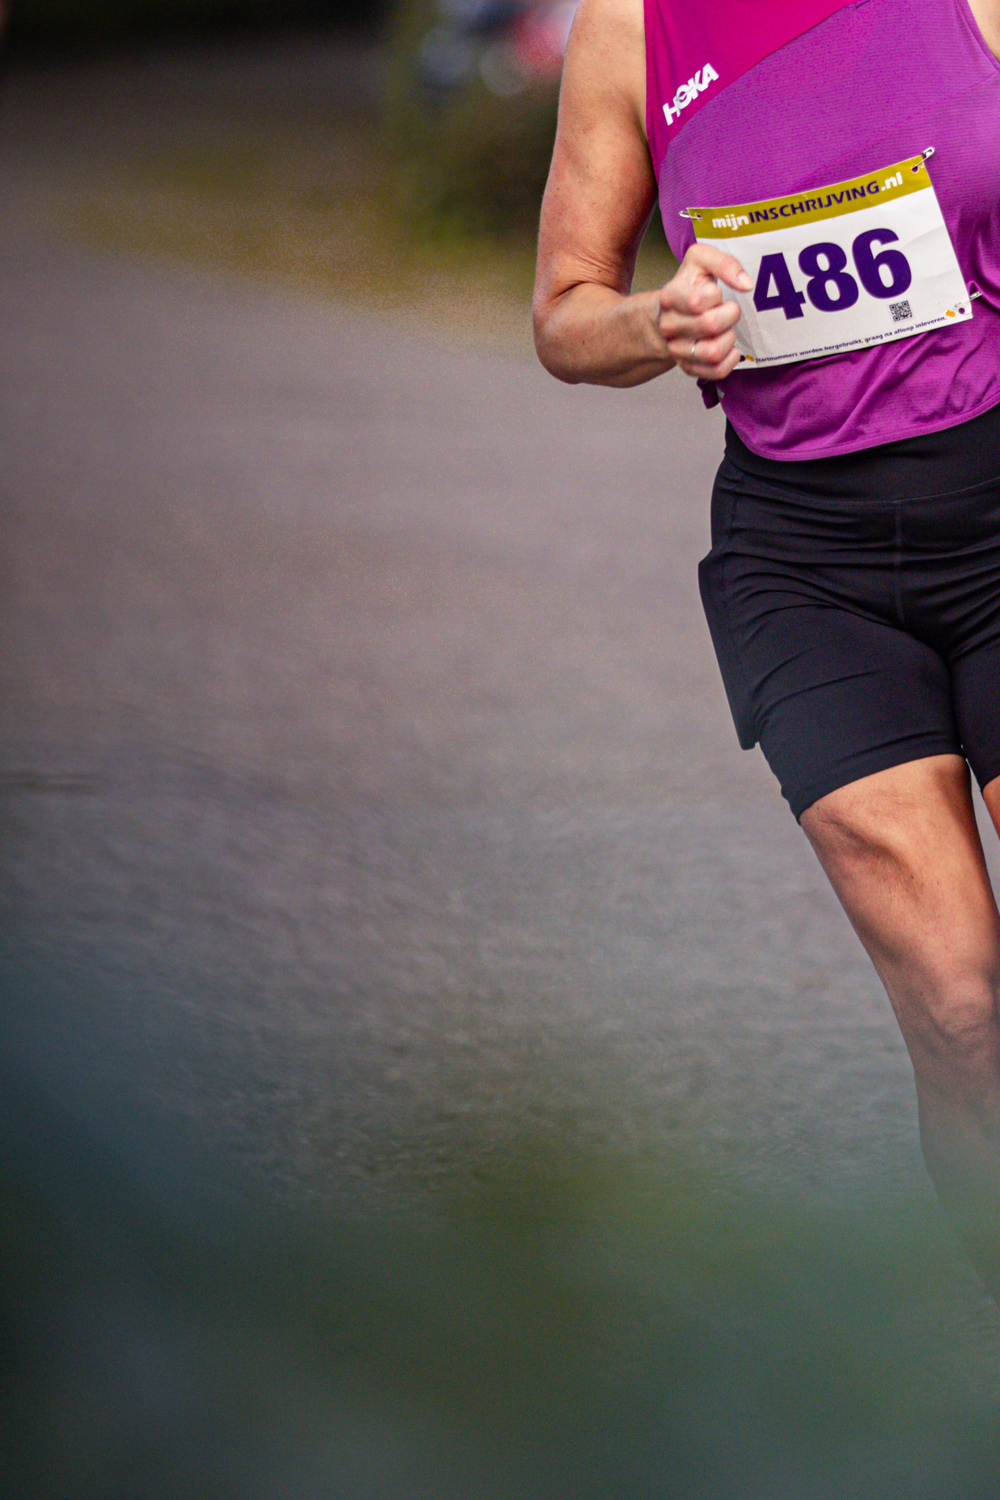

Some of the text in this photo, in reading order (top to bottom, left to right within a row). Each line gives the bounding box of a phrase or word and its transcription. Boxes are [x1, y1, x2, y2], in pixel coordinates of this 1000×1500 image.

[662, 63, 719, 126] HOKA
[712, 172, 904, 231] mijnINSCHRIJVING.nl
[753, 228, 912, 320] 486
[755, 352, 798, 363] Startnummers
[799, 348, 823, 356] worden
[824, 339, 863, 350] hergebruikt,
[864, 334, 883, 343] graag
[894, 326, 914, 335] afloop
[915, 316, 947, 329] inleveren.
